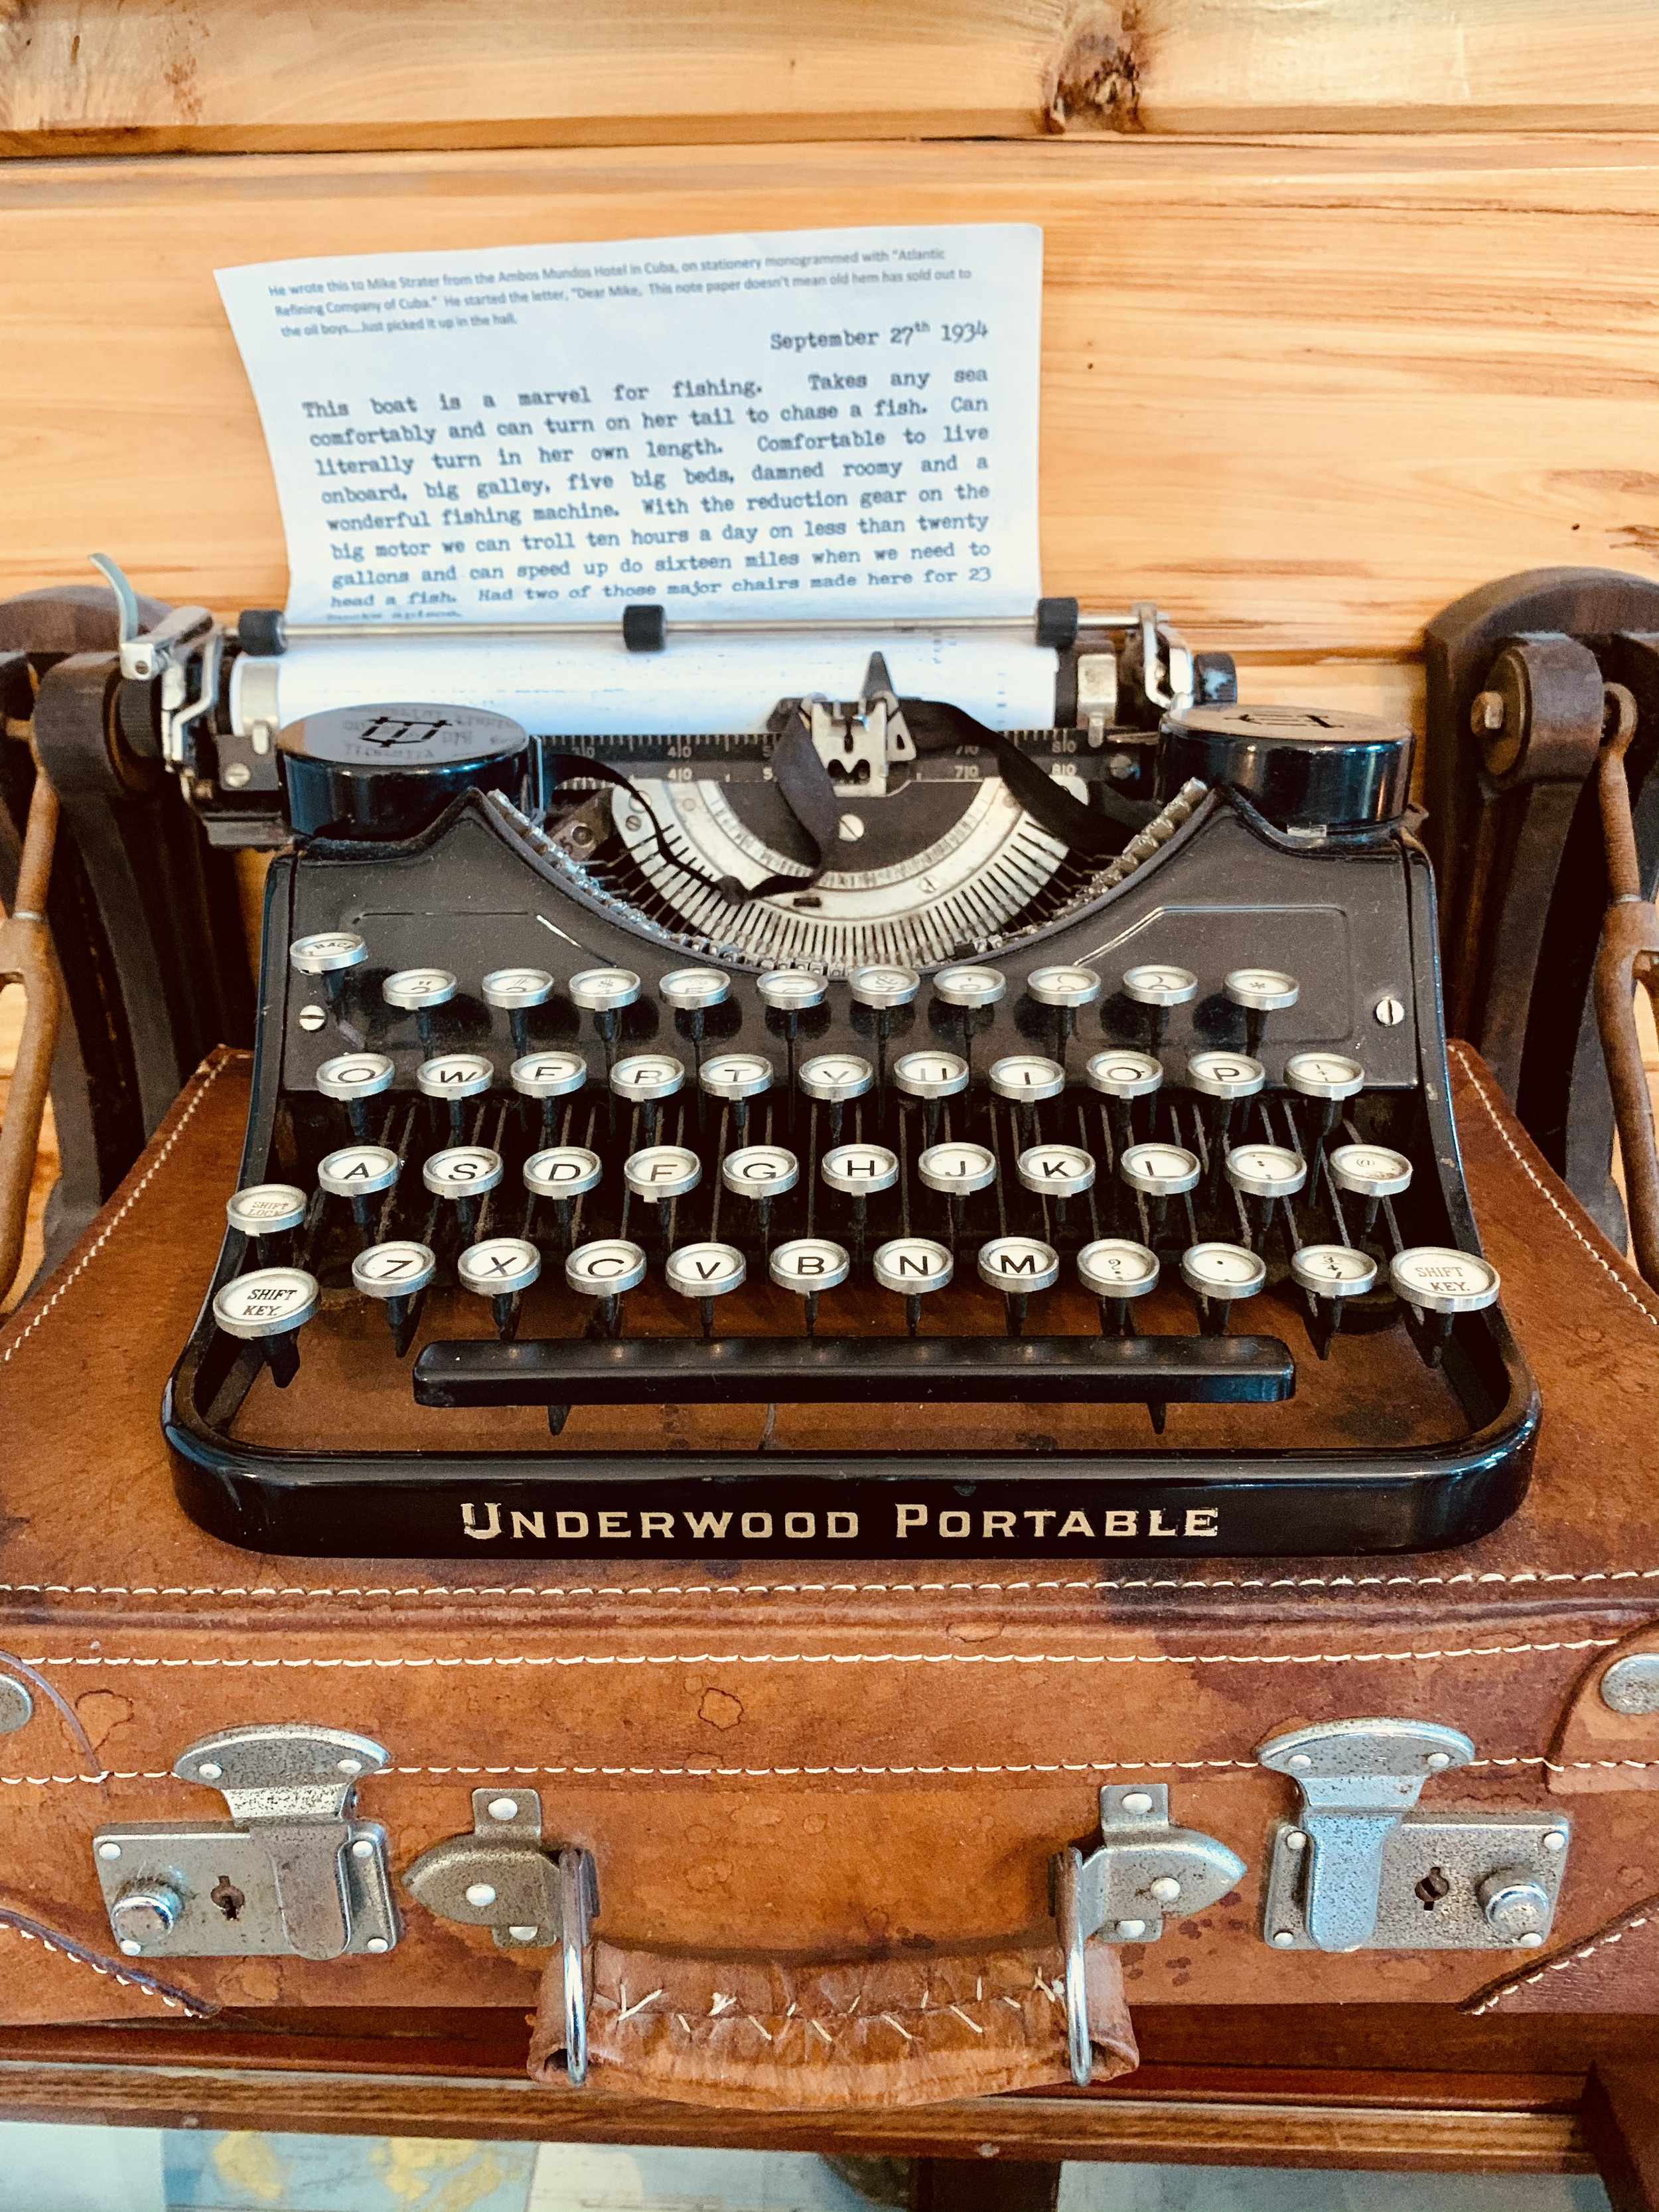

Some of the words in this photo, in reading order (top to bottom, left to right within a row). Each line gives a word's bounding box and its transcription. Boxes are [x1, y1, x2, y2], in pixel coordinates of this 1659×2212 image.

[267, 285, 287, 297] He
[288, 283, 325, 295] wrote
[326, 280, 350, 293] this
[350, 280, 365, 291] to
[366, 278, 397, 290] Mike
[398, 276, 439, 289] Strater
[442, 273, 473, 286] from
[474, 272, 496, 285] the
[593, 263, 628, 277] Hotel
[681, 261, 699, 273] on
[700, 258, 762, 272] stationery
[764, 251, 859, 269] monogrammed
[861, 250, 890, 263] with
[274, 303, 325, 317] Refining
[325, 300, 381, 315] Company
[384, 298, 396, 311] of
[443, 296, 461, 307] He
[463, 292, 507, 307] started
[508, 291, 529, 304] the
[648, 282, 674, 295] This
[675, 282, 704, 294] note
[705, 281, 741, 294] paper
[792, 276, 828, 287] mean
[829, 272, 850, 286] old
[881, 271, 904, 283] has
[906, 268, 932, 283] sold
[934, 269, 956, 281] out
[958, 269, 972, 279] to
[280, 326, 302, 338] the
[303, 323, 319, 336] oil
[386, 318, 425, 334] picked
[437, 318, 455, 330] up
[470, 315, 490, 327] the
[770, 329, 880, 354] September
[941, 320, 989, 344] 1934
[301, 399, 350, 419] This
[369, 396, 418, 415] boat
[439, 393, 461, 411] is
[482, 395, 496, 408] a
[518, 386, 591, 406] marvel
[614, 384, 649, 402] for
[672, 377, 762, 399] fishing.
[807, 372, 868, 391] Takes
[890, 372, 930, 390] any
[954, 369, 988, 384] sea
[309, 423, 437, 447] comfortably
[448, 420, 486, 439] and
[496, 422, 534, 437] can
[544, 417, 595, 435] turn
[605, 417, 630, 431] on
[641, 411, 678, 429] her
[689, 407, 735, 427] tail
[745, 407, 770, 424] to
[780, 404, 839, 422] chase
[849, 404, 863, 418] a
[874, 398, 928, 417] fish.
[950, 396, 988, 413] Can
[315, 455, 415, 477] literally
[431, 453, 482, 470] turn
[498, 447, 522, 467] in
[538, 447, 574, 464] her
[591, 446, 630, 461] own
[646, 437, 723, 460] length.
[757, 429, 886, 453] Comfortable
[902, 427, 926, 445] to
[944, 423, 989, 443] live
[423, 480, 459, 502] big
[476, 477, 551, 500] galley,
[567, 472, 614, 491] five
[630, 469, 667, 490] big
[683, 465, 735, 485] beds,
[751, 461, 824, 481] damned
[843, 461, 903, 479] roomy
[920, 454, 958, 473] and
[976, 456, 988, 470] a
[326, 510, 431, 532] wonderful
[441, 506, 522, 526] fishing
[532, 501, 620, 521] machine.
[641, 497, 689, 516] With
[700, 495, 735, 514] the
[746, 489, 848, 511] reduction
[859, 490, 907, 509] gear
[918, 488, 943, 502] on
[954, 482, 990, 501] the
[330, 542, 365, 563] big
[375, 541, 431, 557] motor
[441, 540, 465, 553] we
[475, 539, 511, 553] can
[521, 532, 576, 551] troll
[586, 532, 620, 548] ten
[630, 528, 689, 546] hours
[699, 528, 712, 542] a
[721, 524, 758, 544] day
[769, 525, 793, 539] on
[804, 520, 847, 538] less
[857, 517, 905, 535] than
[916, 512, 989, 532] twenty
[332, 569, 409, 590] gallons
[421, 564, 457, 582] and
[469, 567, 504, 581] can
[516, 559, 571, 581] speed
[583, 562, 609, 578] up
[620, 557, 643, 573] do
[654, 555, 732, 572] sixteen
[745, 550, 800, 567] miles
[812, 548, 861, 564] when
[873, 548, 899, 561] we
[910, 542, 955, 560] need
[968, 542, 991, 557] to
[330, 594, 374, 608] head
[385, 596, 396, 605] a
[409, 591, 457, 605] fish.
[478, 587, 514, 601] Had
[524, 587, 559, 600] two
[568, 585, 591, 599] of
[602, 584, 656, 598] those
[667, 580, 722, 597] major
[731, 576, 800, 592] chairs
[810, 573, 857, 589] made
[867, 572, 914, 585] here
[924, 569, 958, 583] for
[968, 566, 991, 582] 23
[342, 1162, 370, 1179] A
[448, 1163, 478, 1180] S
[547, 1163, 581, 1180] D
[743, 1163, 777, 1179] G
[847, 1159, 875, 1176] H
[1042, 1161, 1070, 1177] K
[252, 1201, 289, 1211] SHIFT
[482, 1256, 518, 1276] X
[587, 1258, 624, 1276] C
[695, 1261, 721, 1279] V
[797, 1256, 825, 1275] B
[899, 1255, 928, 1276] N
[1000, 1254, 1036, 1274] M
[1414, 1266, 1464, 1278] SHIFT
[247, 1288, 297, 1301] SHIFT
[460, 1502, 859, 1540] UNDERWOOD
[895, 1504, 1220, 1538] PORTABLE
